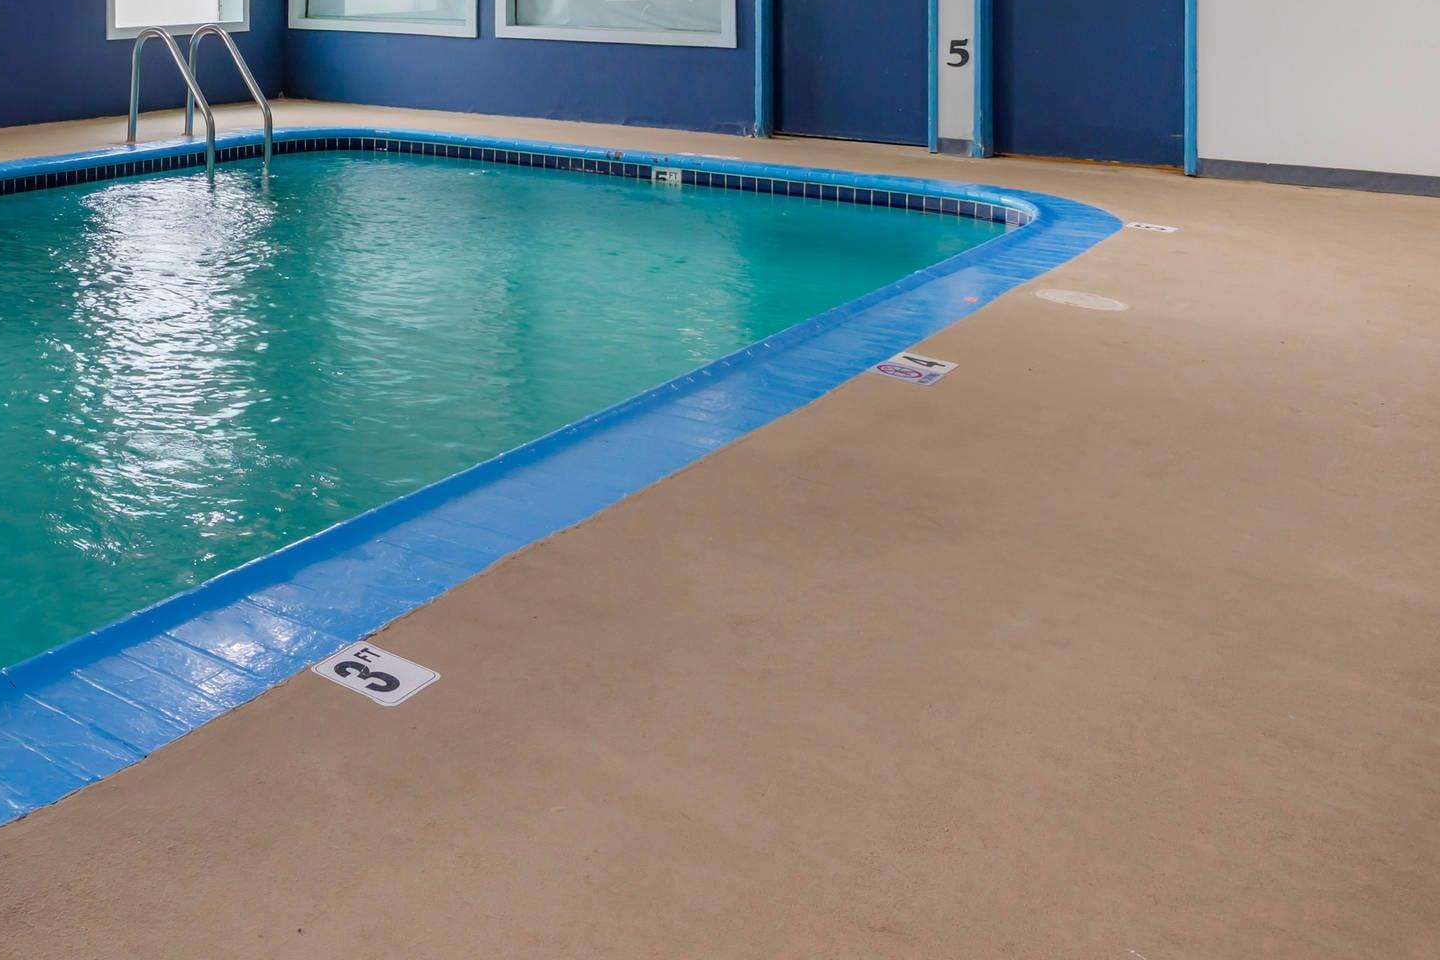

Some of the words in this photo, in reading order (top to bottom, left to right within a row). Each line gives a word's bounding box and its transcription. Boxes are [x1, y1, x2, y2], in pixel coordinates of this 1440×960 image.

[946, 38, 970, 68] 5
[353, 647, 381, 663] FT
[333, 660, 401, 693] 3
